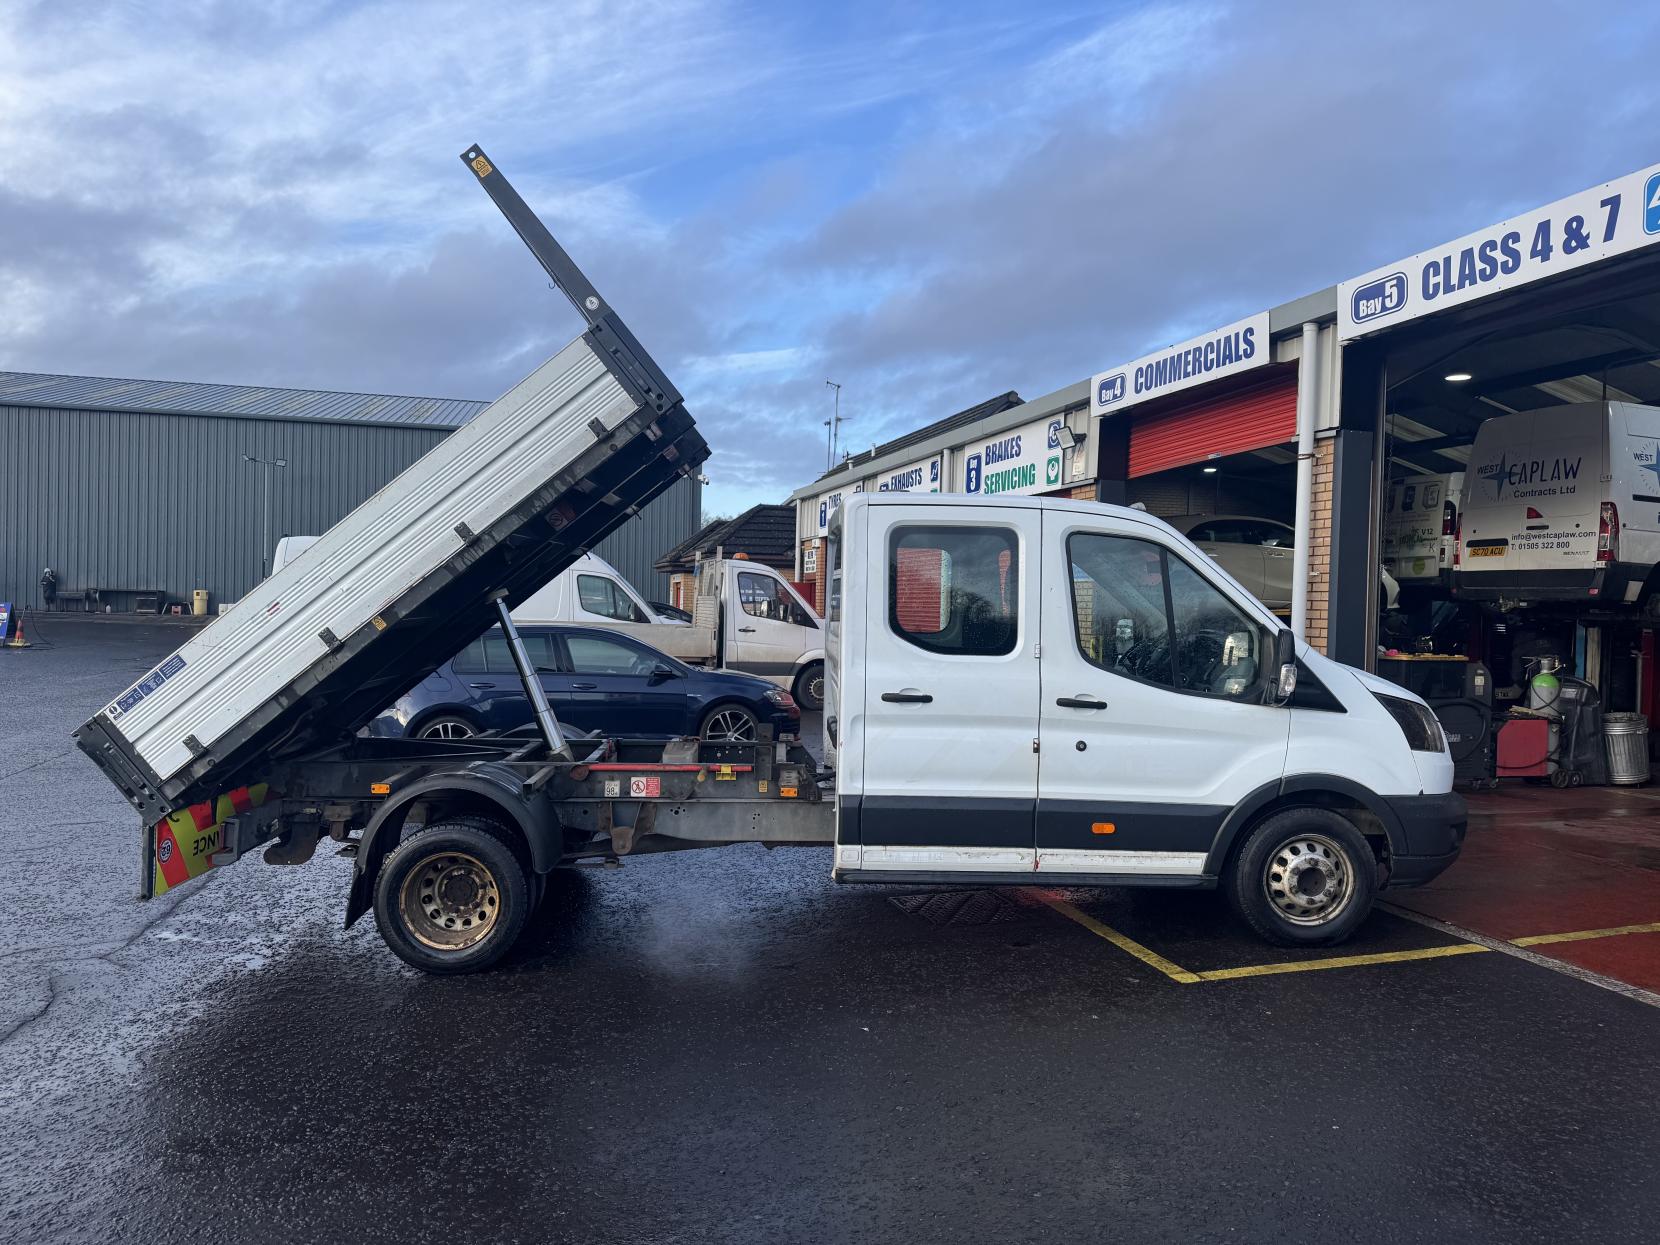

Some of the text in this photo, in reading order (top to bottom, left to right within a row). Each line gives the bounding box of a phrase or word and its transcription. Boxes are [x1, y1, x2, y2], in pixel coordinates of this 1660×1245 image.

[1421, 193, 1621, 301] CLASS 4 & 7
[1359, 280, 1398, 318] Bay 5
[1134, 326, 1255, 395] COMMERCIALS
[1101, 379, 1121, 402] Bay 4
[985, 435, 1022, 466] BRAKES
[1633, 452, 1654, 462] WEST
[890, 467, 923, 492] EXHAUSTS
[970, 470, 976, 490] 3
[984, 463, 1036, 495] SERVICING
[1477, 463, 1500, 475] WEST
[1508, 457, 1582, 486] CAPLAW
[1513, 485, 1576, 498] Contracts Ltd
[1510, 541, 1570, 551] T: 01505 322 800
[1511, 530, 1597, 542] info@westcaplaw.com
[606, 787, 615, 796] 98
